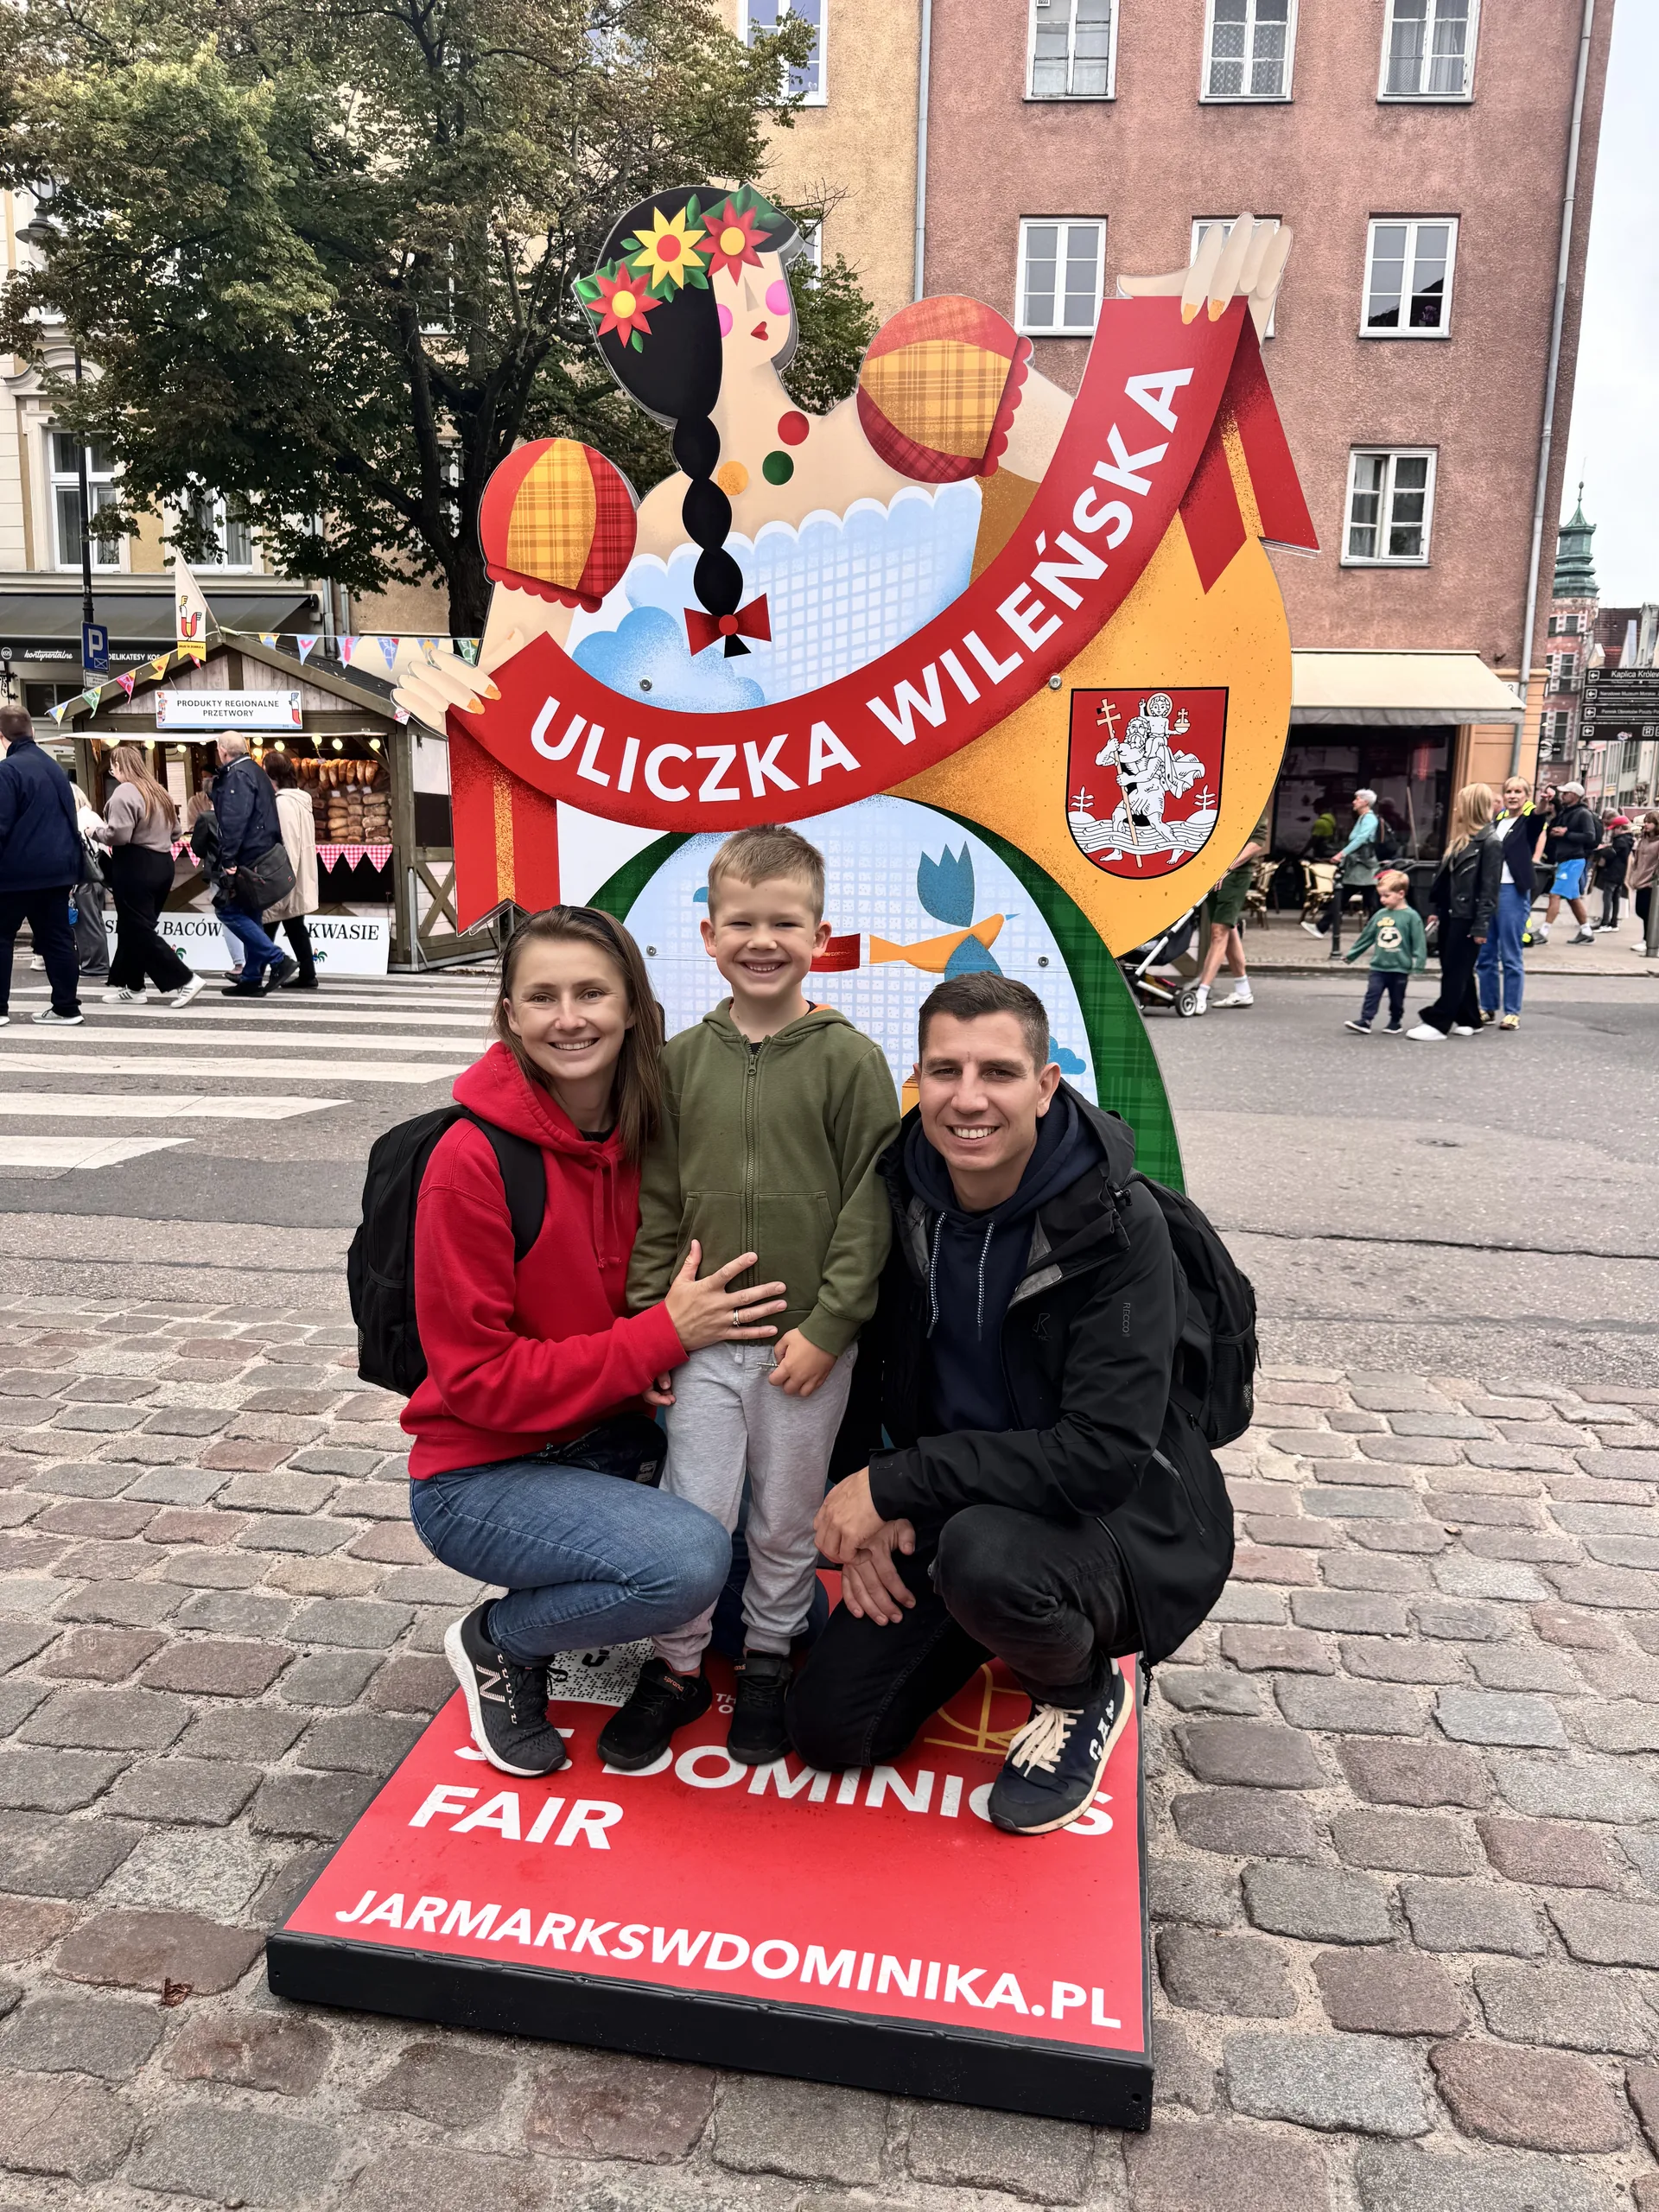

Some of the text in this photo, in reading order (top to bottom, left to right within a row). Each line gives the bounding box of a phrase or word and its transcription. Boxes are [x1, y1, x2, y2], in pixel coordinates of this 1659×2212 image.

[531, 368, 1193, 802] ULICZKA WILEŃSKA
[88, 628, 103, 658] P
[162, 918, 225, 937] BACÓW
[308, 923, 379, 940] KWASIE
[715, 1693, 737, 1705] TH
[408, 1784, 623, 1850] FAIR
[335, 1890, 1122, 2029] JARMARKSWDOMINIKA.PL
